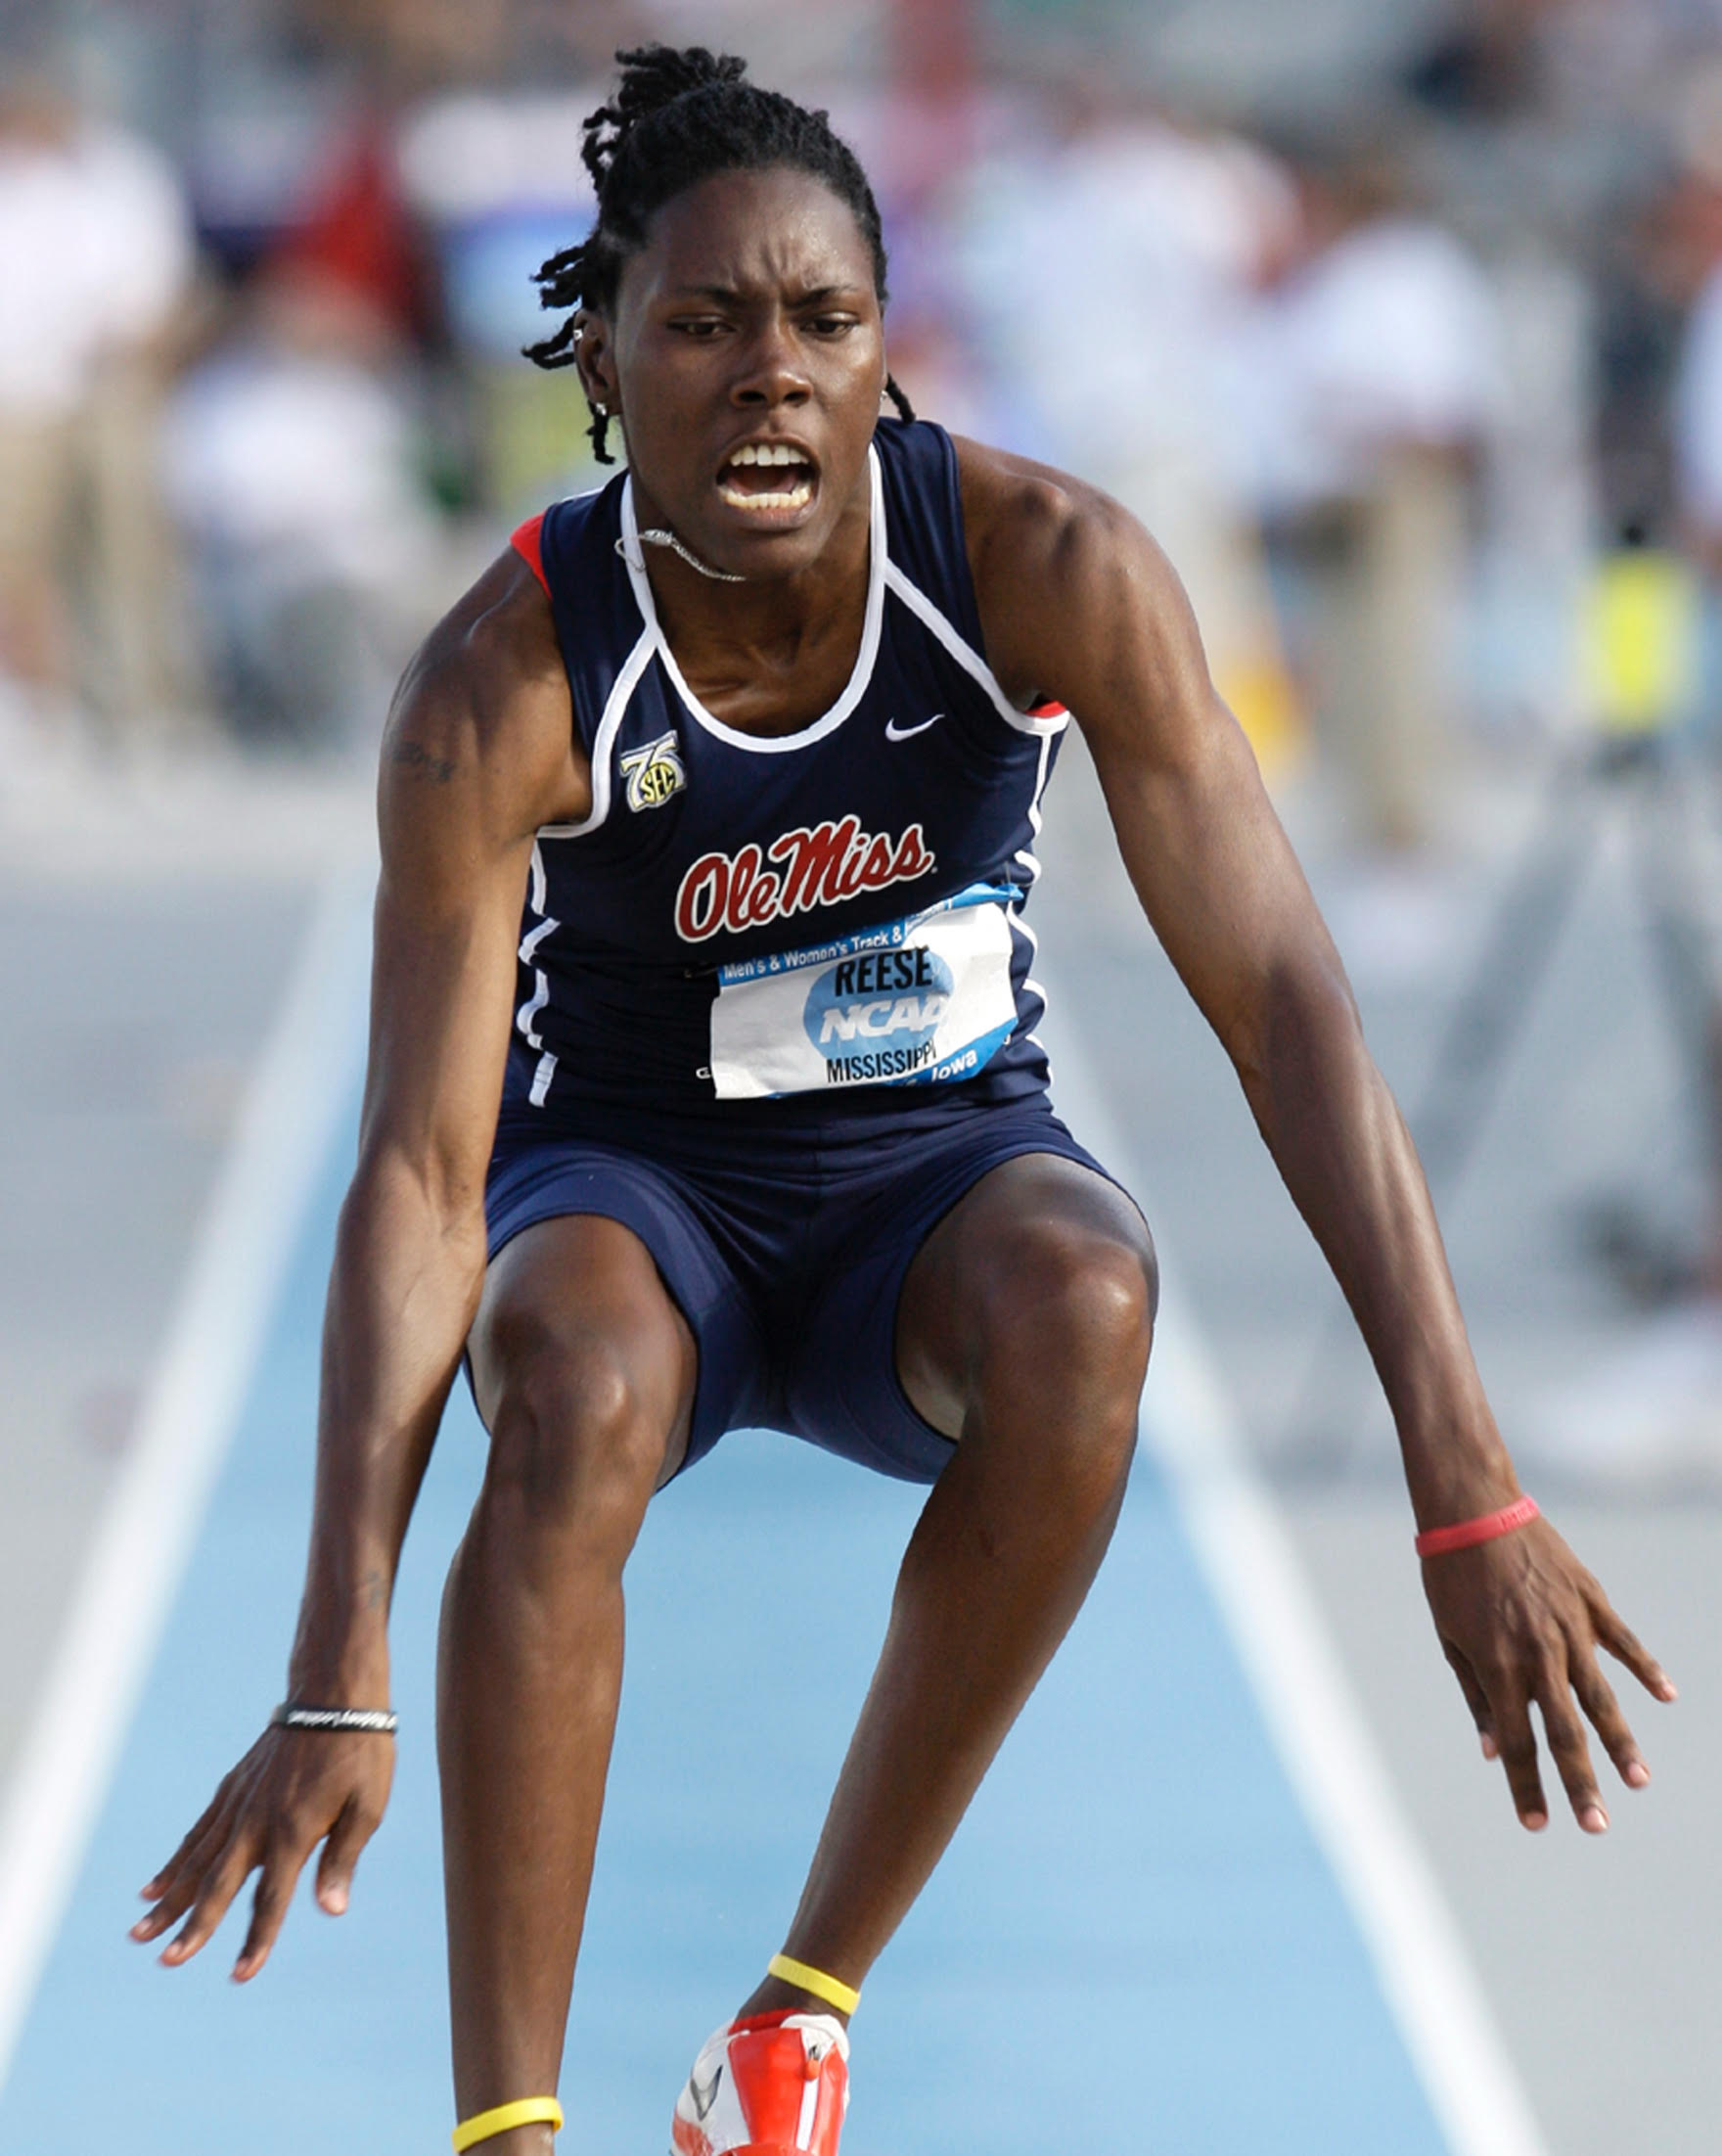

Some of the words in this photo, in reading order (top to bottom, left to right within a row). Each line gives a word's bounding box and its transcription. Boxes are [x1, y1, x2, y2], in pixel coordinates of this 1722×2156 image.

[639, 763, 676, 803] SEC
[724, 958, 765, 980] Men's
[770, 954, 781, 972] &
[784, 941, 849, 967] Women's
[850, 929, 889, 951] Track
[891, 926, 903, 943] &
[836, 945, 932, 997] REESE
[819, 995, 950, 1044] NCAA
[930, 1049, 977, 1082] Iowa
